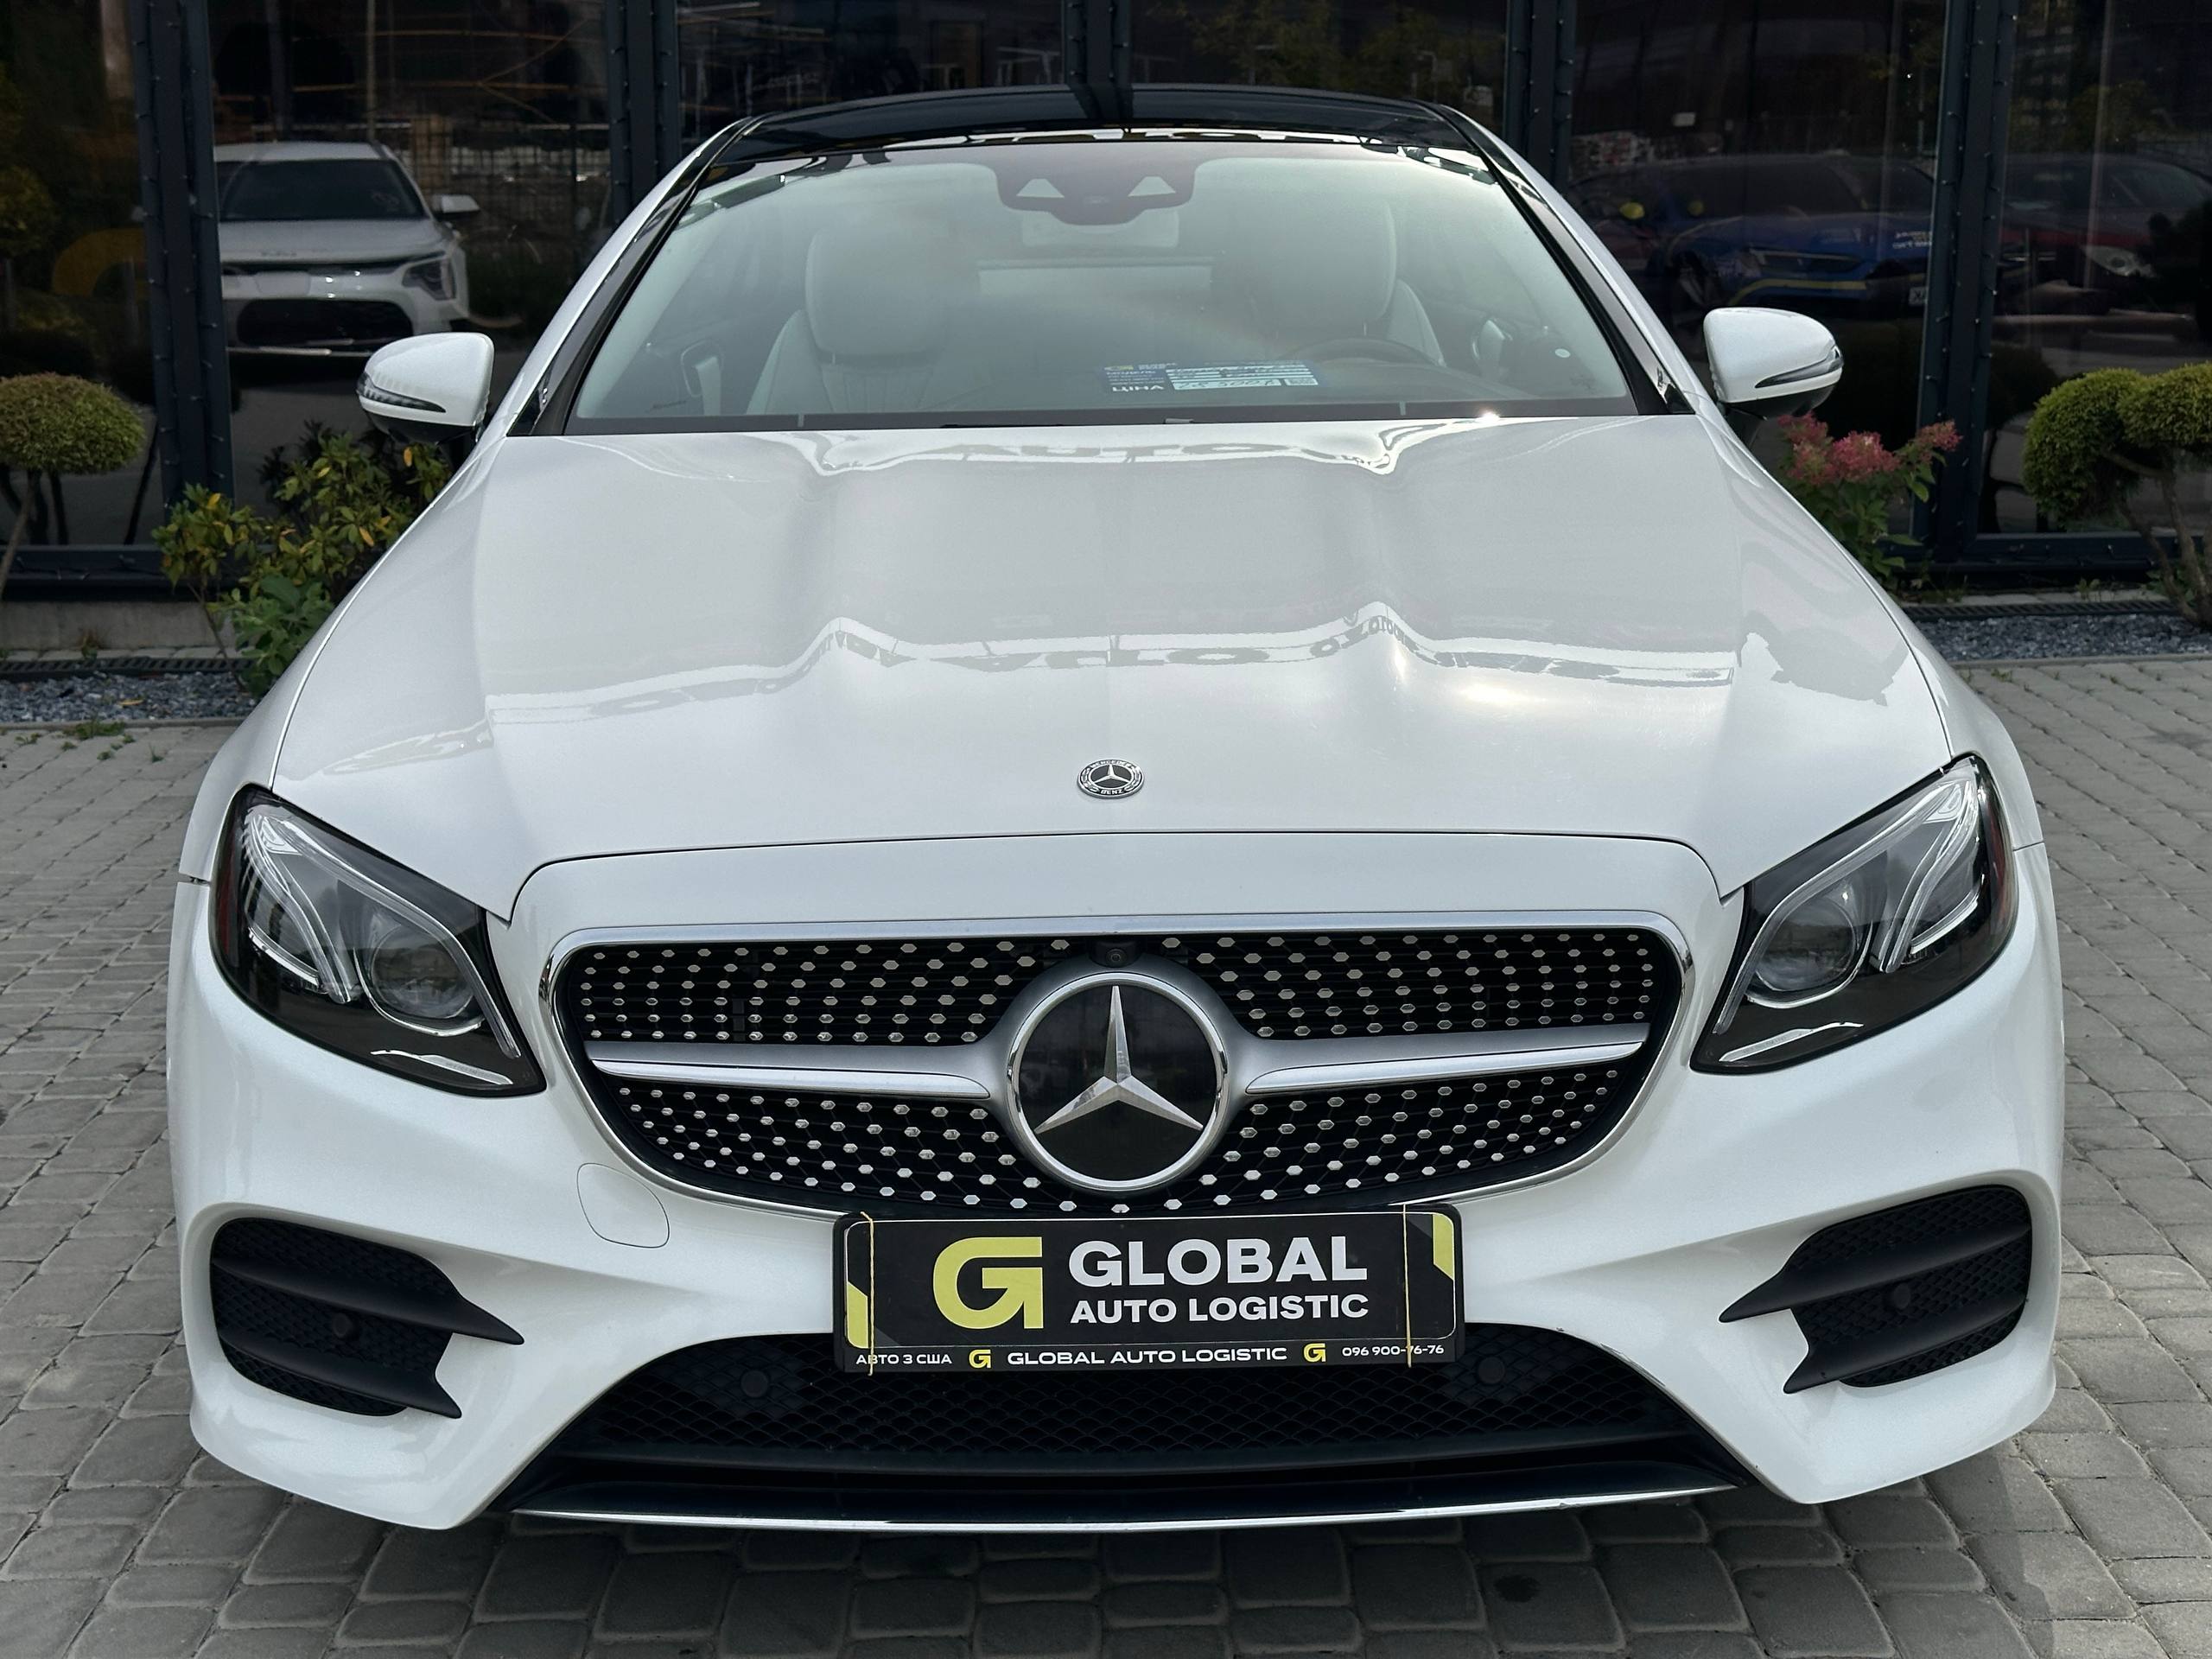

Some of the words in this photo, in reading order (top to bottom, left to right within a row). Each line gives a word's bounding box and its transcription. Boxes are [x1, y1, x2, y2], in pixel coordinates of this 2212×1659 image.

[1069, 1236, 1368, 1287] GLOBAL
[1070, 1298, 1178, 1325] AUTO
[1189, 1294, 1370, 1323] LOGISTIC
[916, 1353, 953, 1365] США
[1007, 1351, 1105, 1365] GLOBAL
[1109, 1350, 1176, 1363] AUTO
[1181, 1347, 1287, 1363] LOGISTIC
[1342, 1346, 1370, 1357] 096
